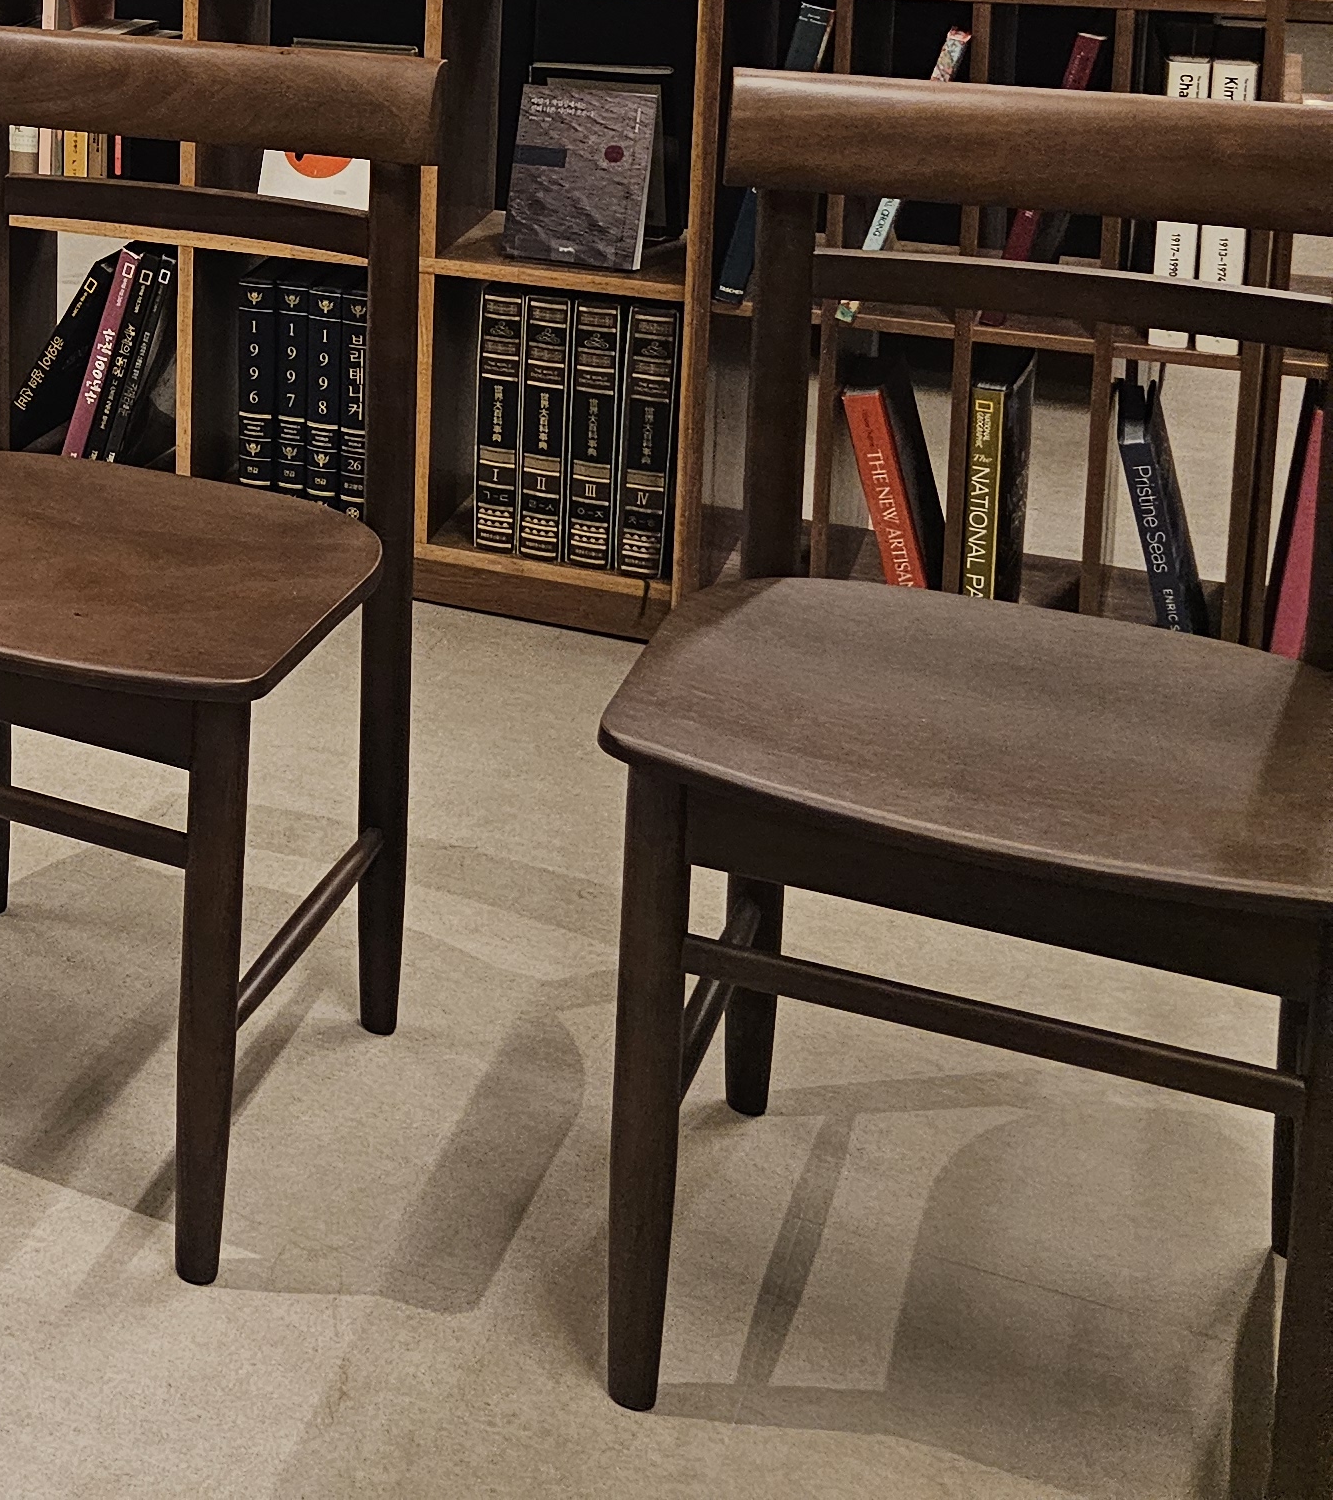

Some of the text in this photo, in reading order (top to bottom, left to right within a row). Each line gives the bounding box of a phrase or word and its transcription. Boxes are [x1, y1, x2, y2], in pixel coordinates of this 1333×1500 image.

[719, 285, 745, 295] TASCHEN
[98, 329, 116, 356] 사진
[112, 323, 136, 377] 세계의 동굴
[14, 336, 64, 411] 하와이 섬의 신비
[249, 320, 259, 404] 1996
[286, 323, 297, 408] 1997
[318, 329, 328, 415] 1998
[348, 334, 367, 421] 브리태니커
[975, 412, 983, 448] GEOGRAPHIC
[347, 459, 362, 472] 26
[492, 469, 498, 482] I
[973, 453, 992, 463] The
[536, 477, 546, 490] II
[585, 484, 597, 497] III
[637, 492, 649, 505] IV
[866, 449, 888, 484] THE
[877, 487, 900, 524] NEW
[966, 466, 990, 569] NATIONAL
[1133, 465, 1168, 573] Pristine Seas
[1162, 588, 1178, 622] ENRIC
